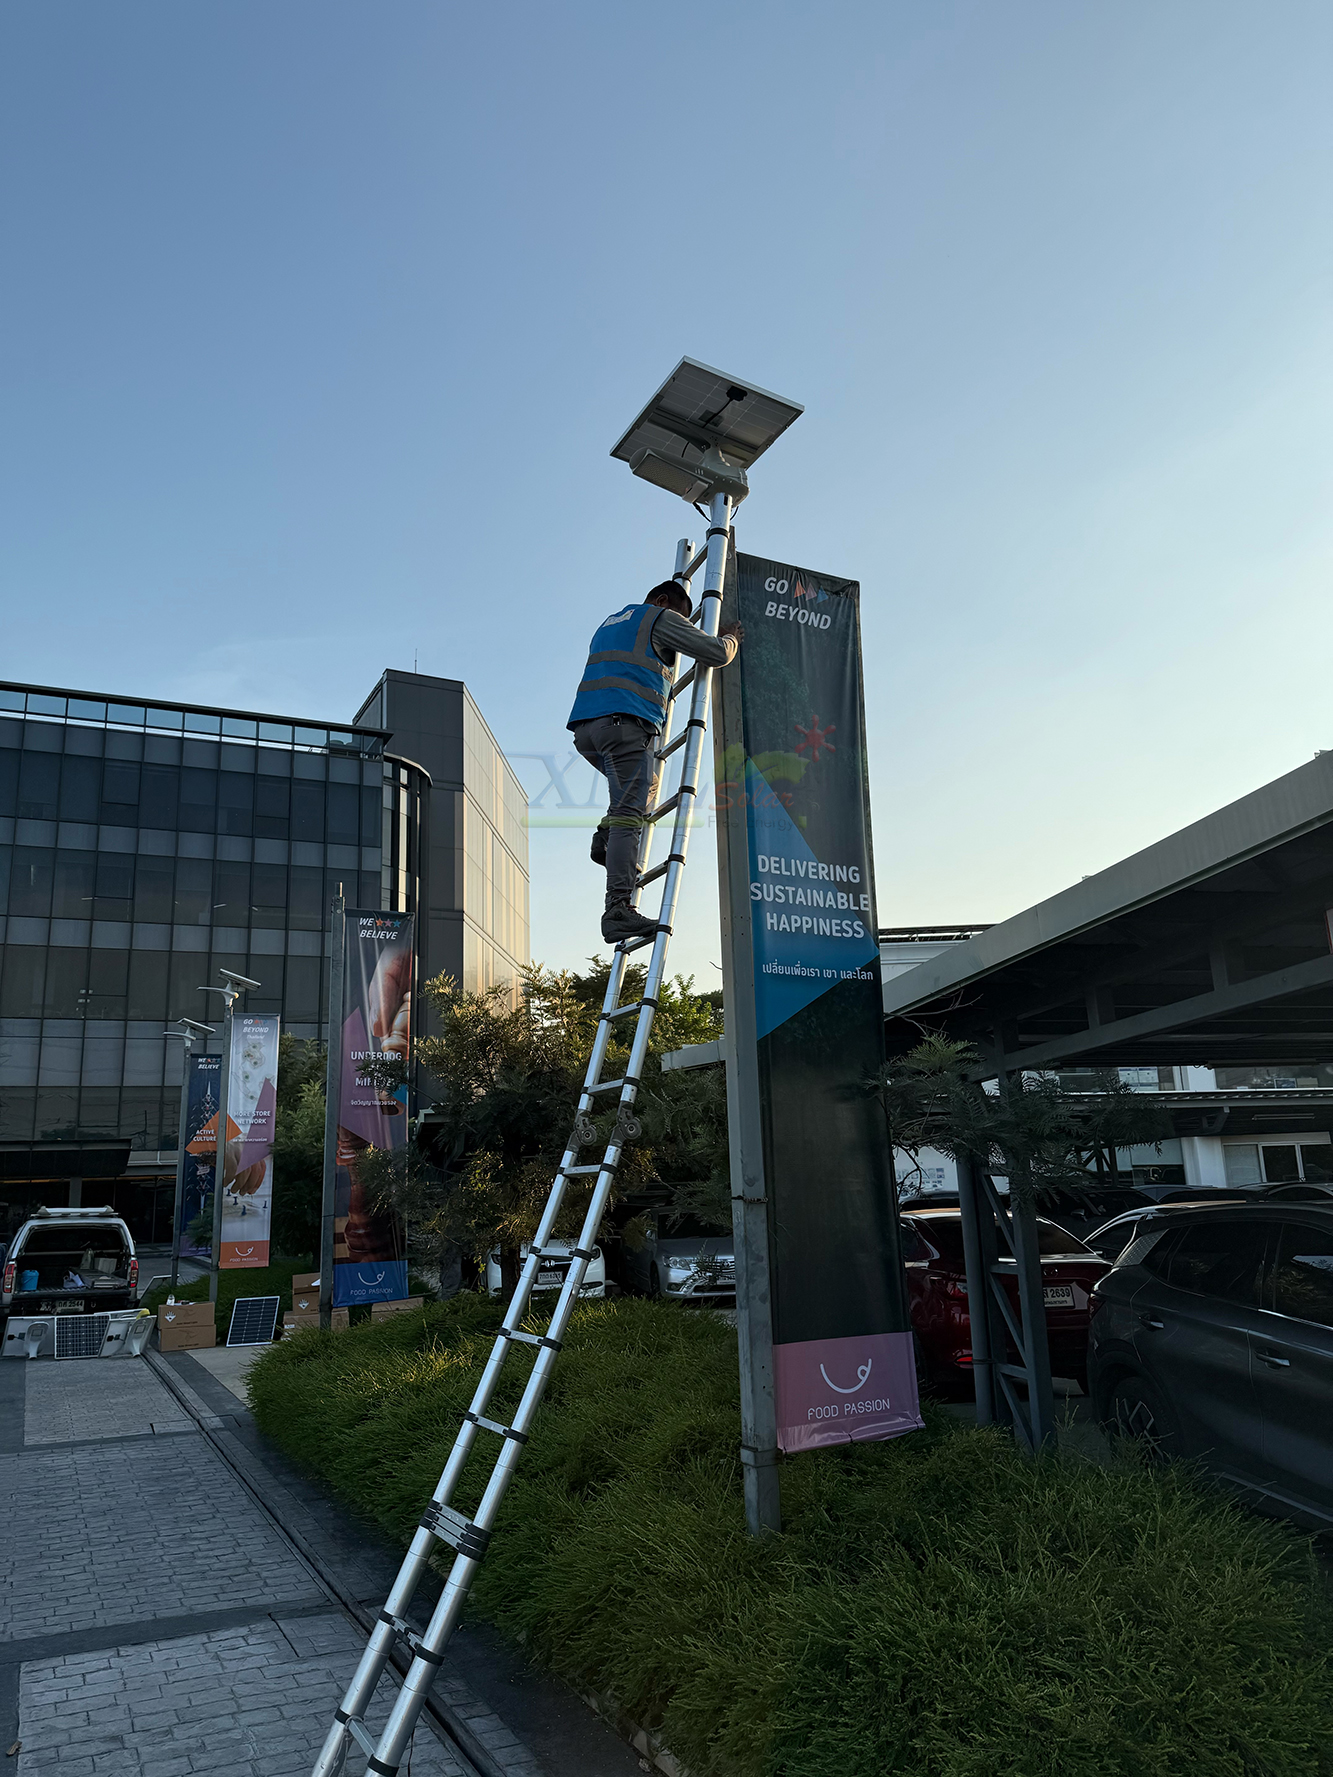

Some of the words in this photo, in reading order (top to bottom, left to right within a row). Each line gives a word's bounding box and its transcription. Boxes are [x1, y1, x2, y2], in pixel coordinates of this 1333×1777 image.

[764, 576, 789, 594] GO
[764, 601, 832, 630] BEYOND
[757, 854, 861, 883] DELIVERING
[750, 882, 870, 911] SUSTAINABLE
[359, 917, 374, 926] WE
[766, 912, 865, 939] HAPPINESS
[359, 929, 398, 940] BELIEVE
[762, 958, 820, 978] เปลี่ยนเพื่อเรา
[823, 967, 838, 978] เขา
[840, 966, 874, 980] และโลก
[350, 1051, 403, 1061] UNDERDOG
[350, 1288, 367, 1296] FOOD
[1049, 1288, 1070, 1298] 2639
[807, 1405, 839, 1420] FOOD
[844, 1398, 891, 1415] PASSION
